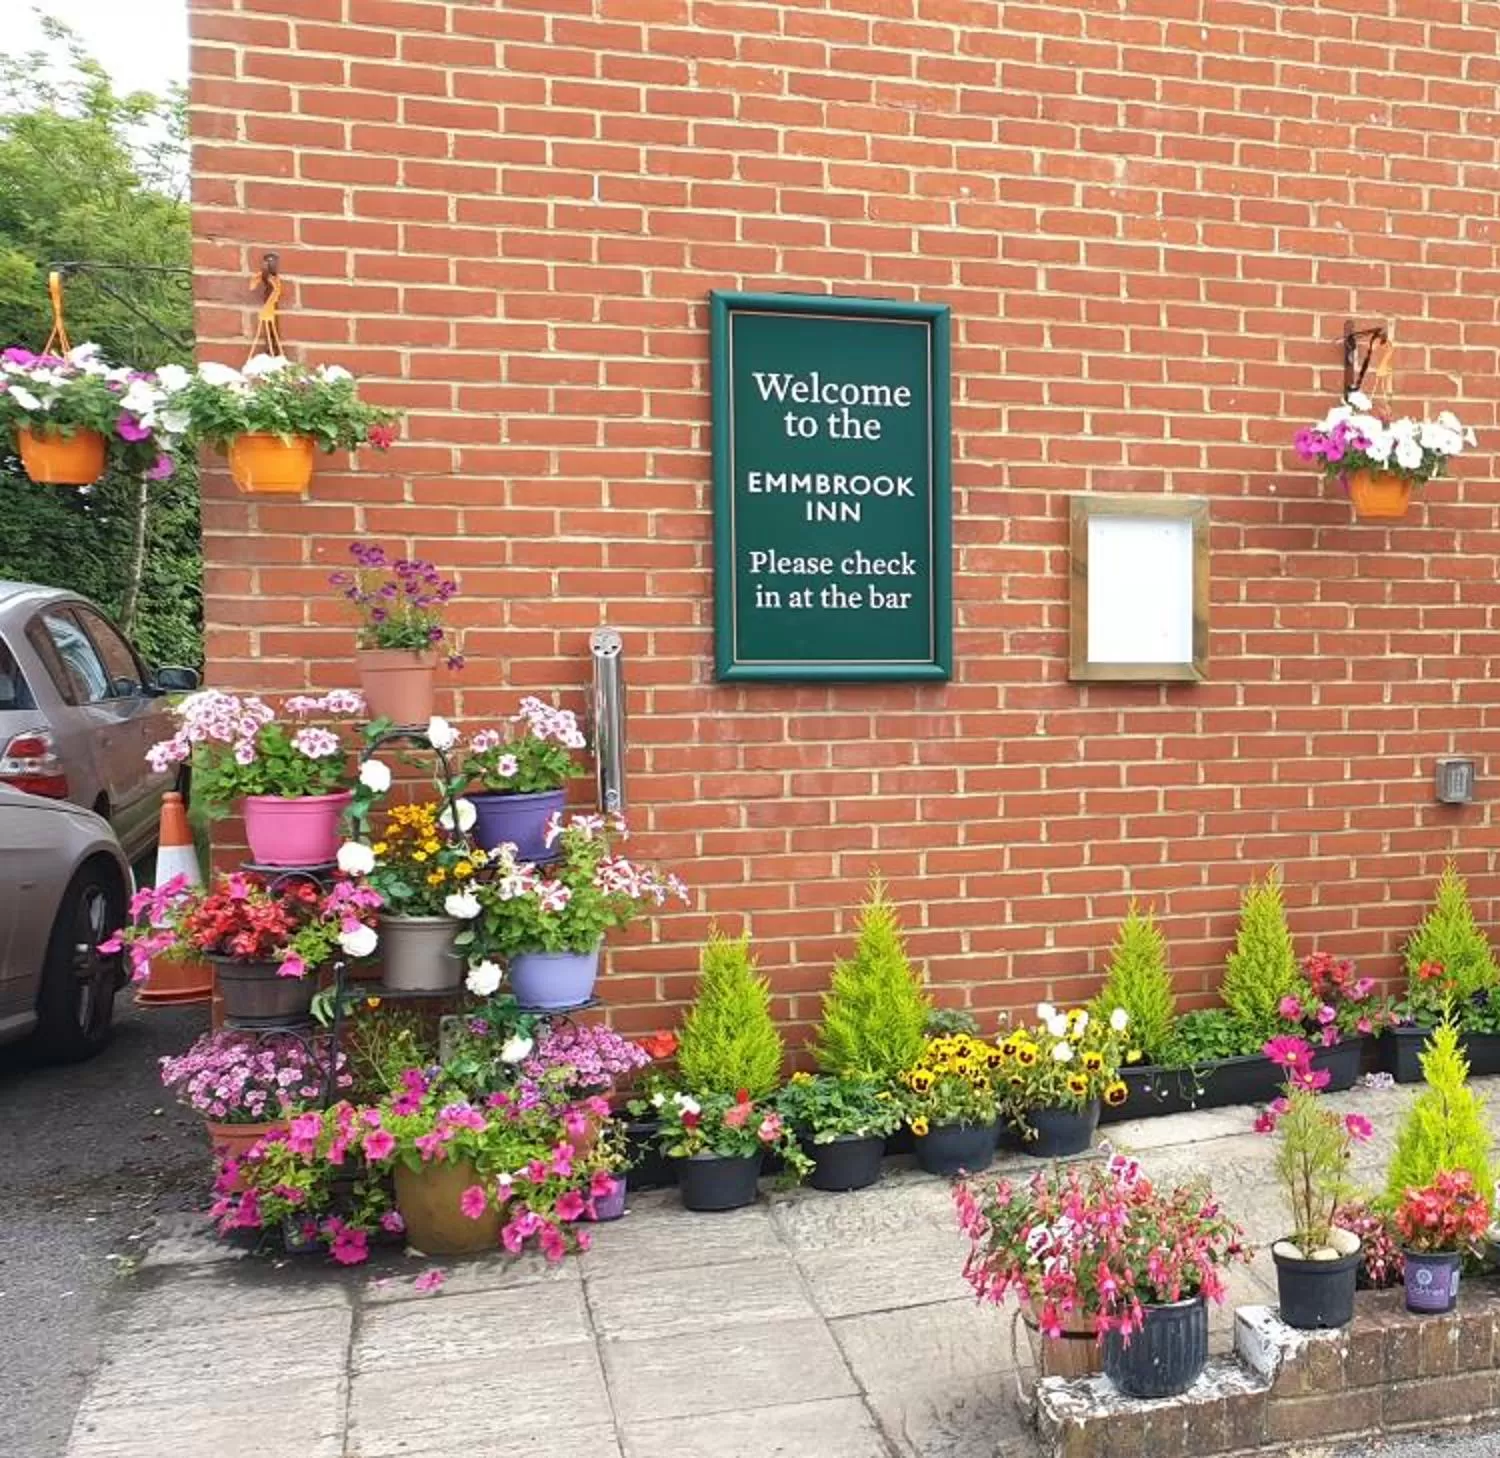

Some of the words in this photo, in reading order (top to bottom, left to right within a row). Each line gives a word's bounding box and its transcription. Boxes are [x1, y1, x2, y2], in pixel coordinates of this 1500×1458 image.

[752, 372, 911, 407] Welcome
[784, 411, 819, 438] to
[827, 408, 881, 440] the
[748, 472, 915, 497] EMMBROOK
[807, 501, 861, 522] INN
[750, 549, 834, 575] Please
[841, 550, 917, 576] check
[756, 584, 781, 608] in
[789, 588, 814, 609] at
[821, 584, 863, 609] the
[869, 585, 912, 609] bar
